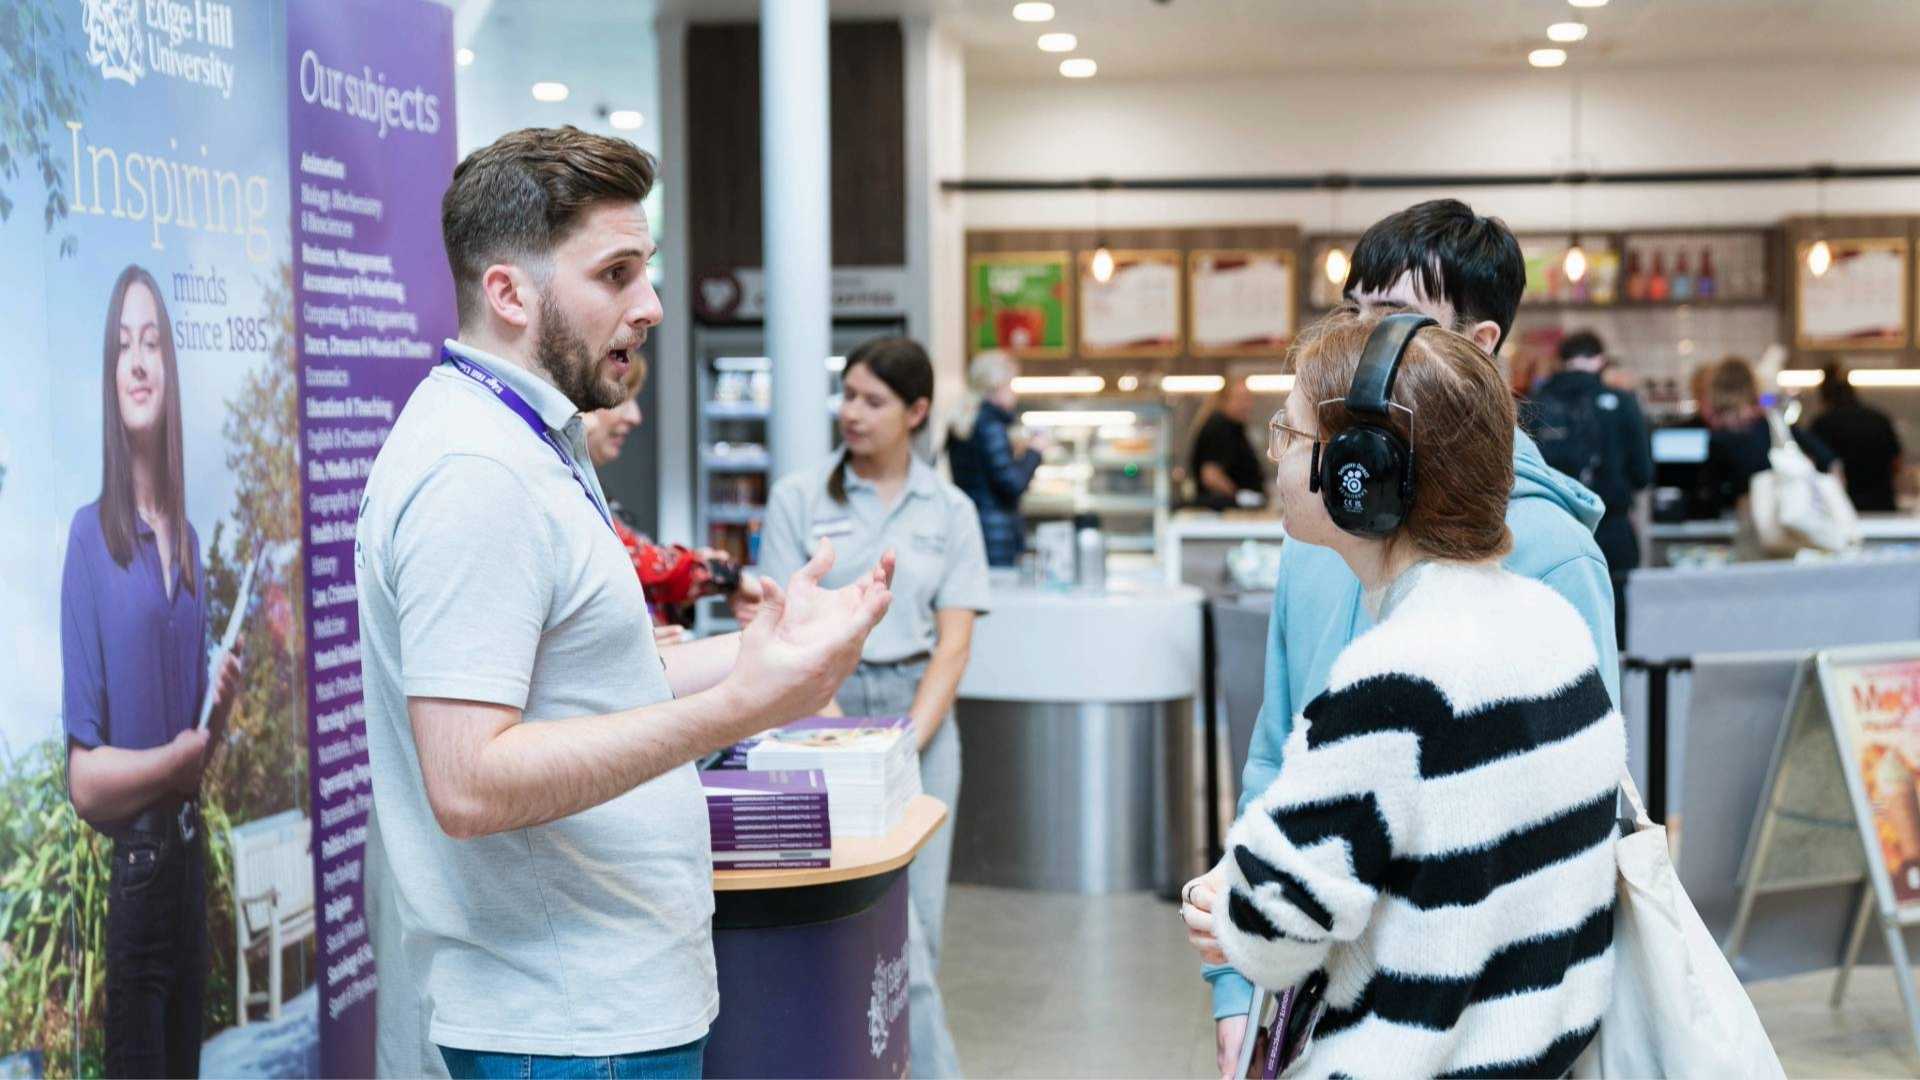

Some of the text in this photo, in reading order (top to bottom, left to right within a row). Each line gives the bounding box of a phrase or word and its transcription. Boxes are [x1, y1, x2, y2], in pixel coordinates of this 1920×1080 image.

[146, 0, 233, 49] Edge Hill
[148, 31, 233, 100] University
[300, 48, 441, 139] Our subjects
[67, 120, 271, 264] Inspiring
[172, 263, 227, 306] minds
[175, 311, 222, 351] since
